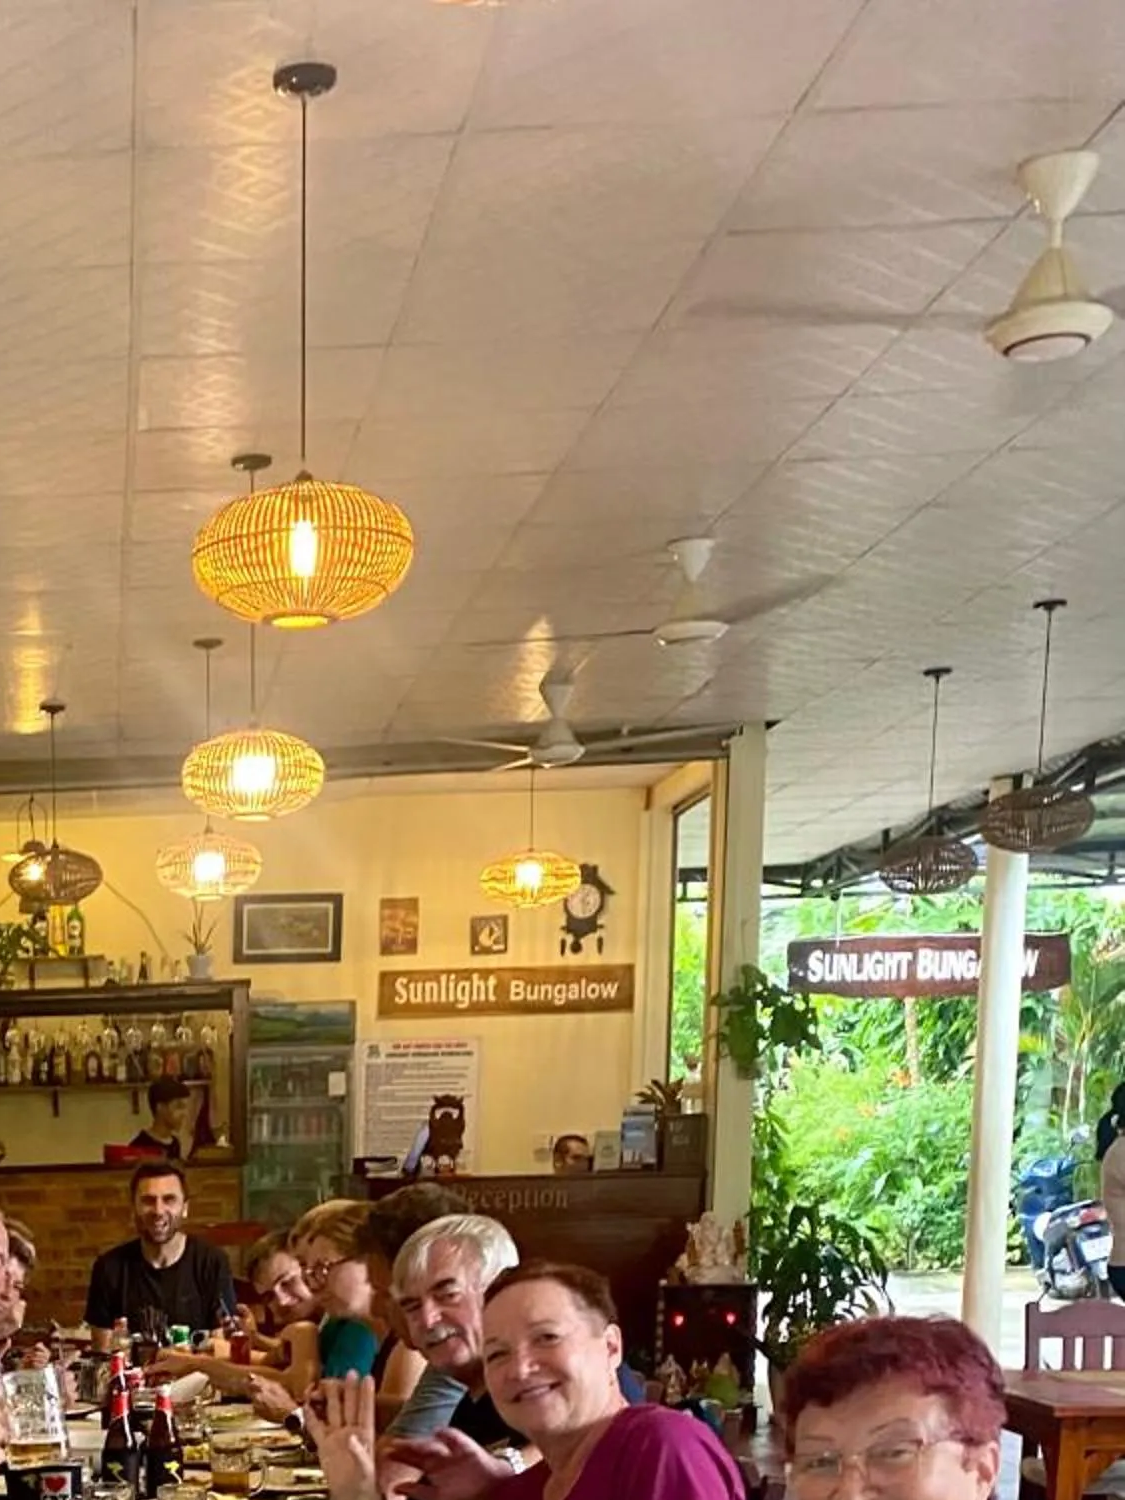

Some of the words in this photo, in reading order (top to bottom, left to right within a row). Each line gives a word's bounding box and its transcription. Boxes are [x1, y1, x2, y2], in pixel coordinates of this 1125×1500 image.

[917, 948, 1040, 981] BUNGW
[394, 972, 497, 1009] Sunlight
[510, 978, 619, 1005] Bungalow
